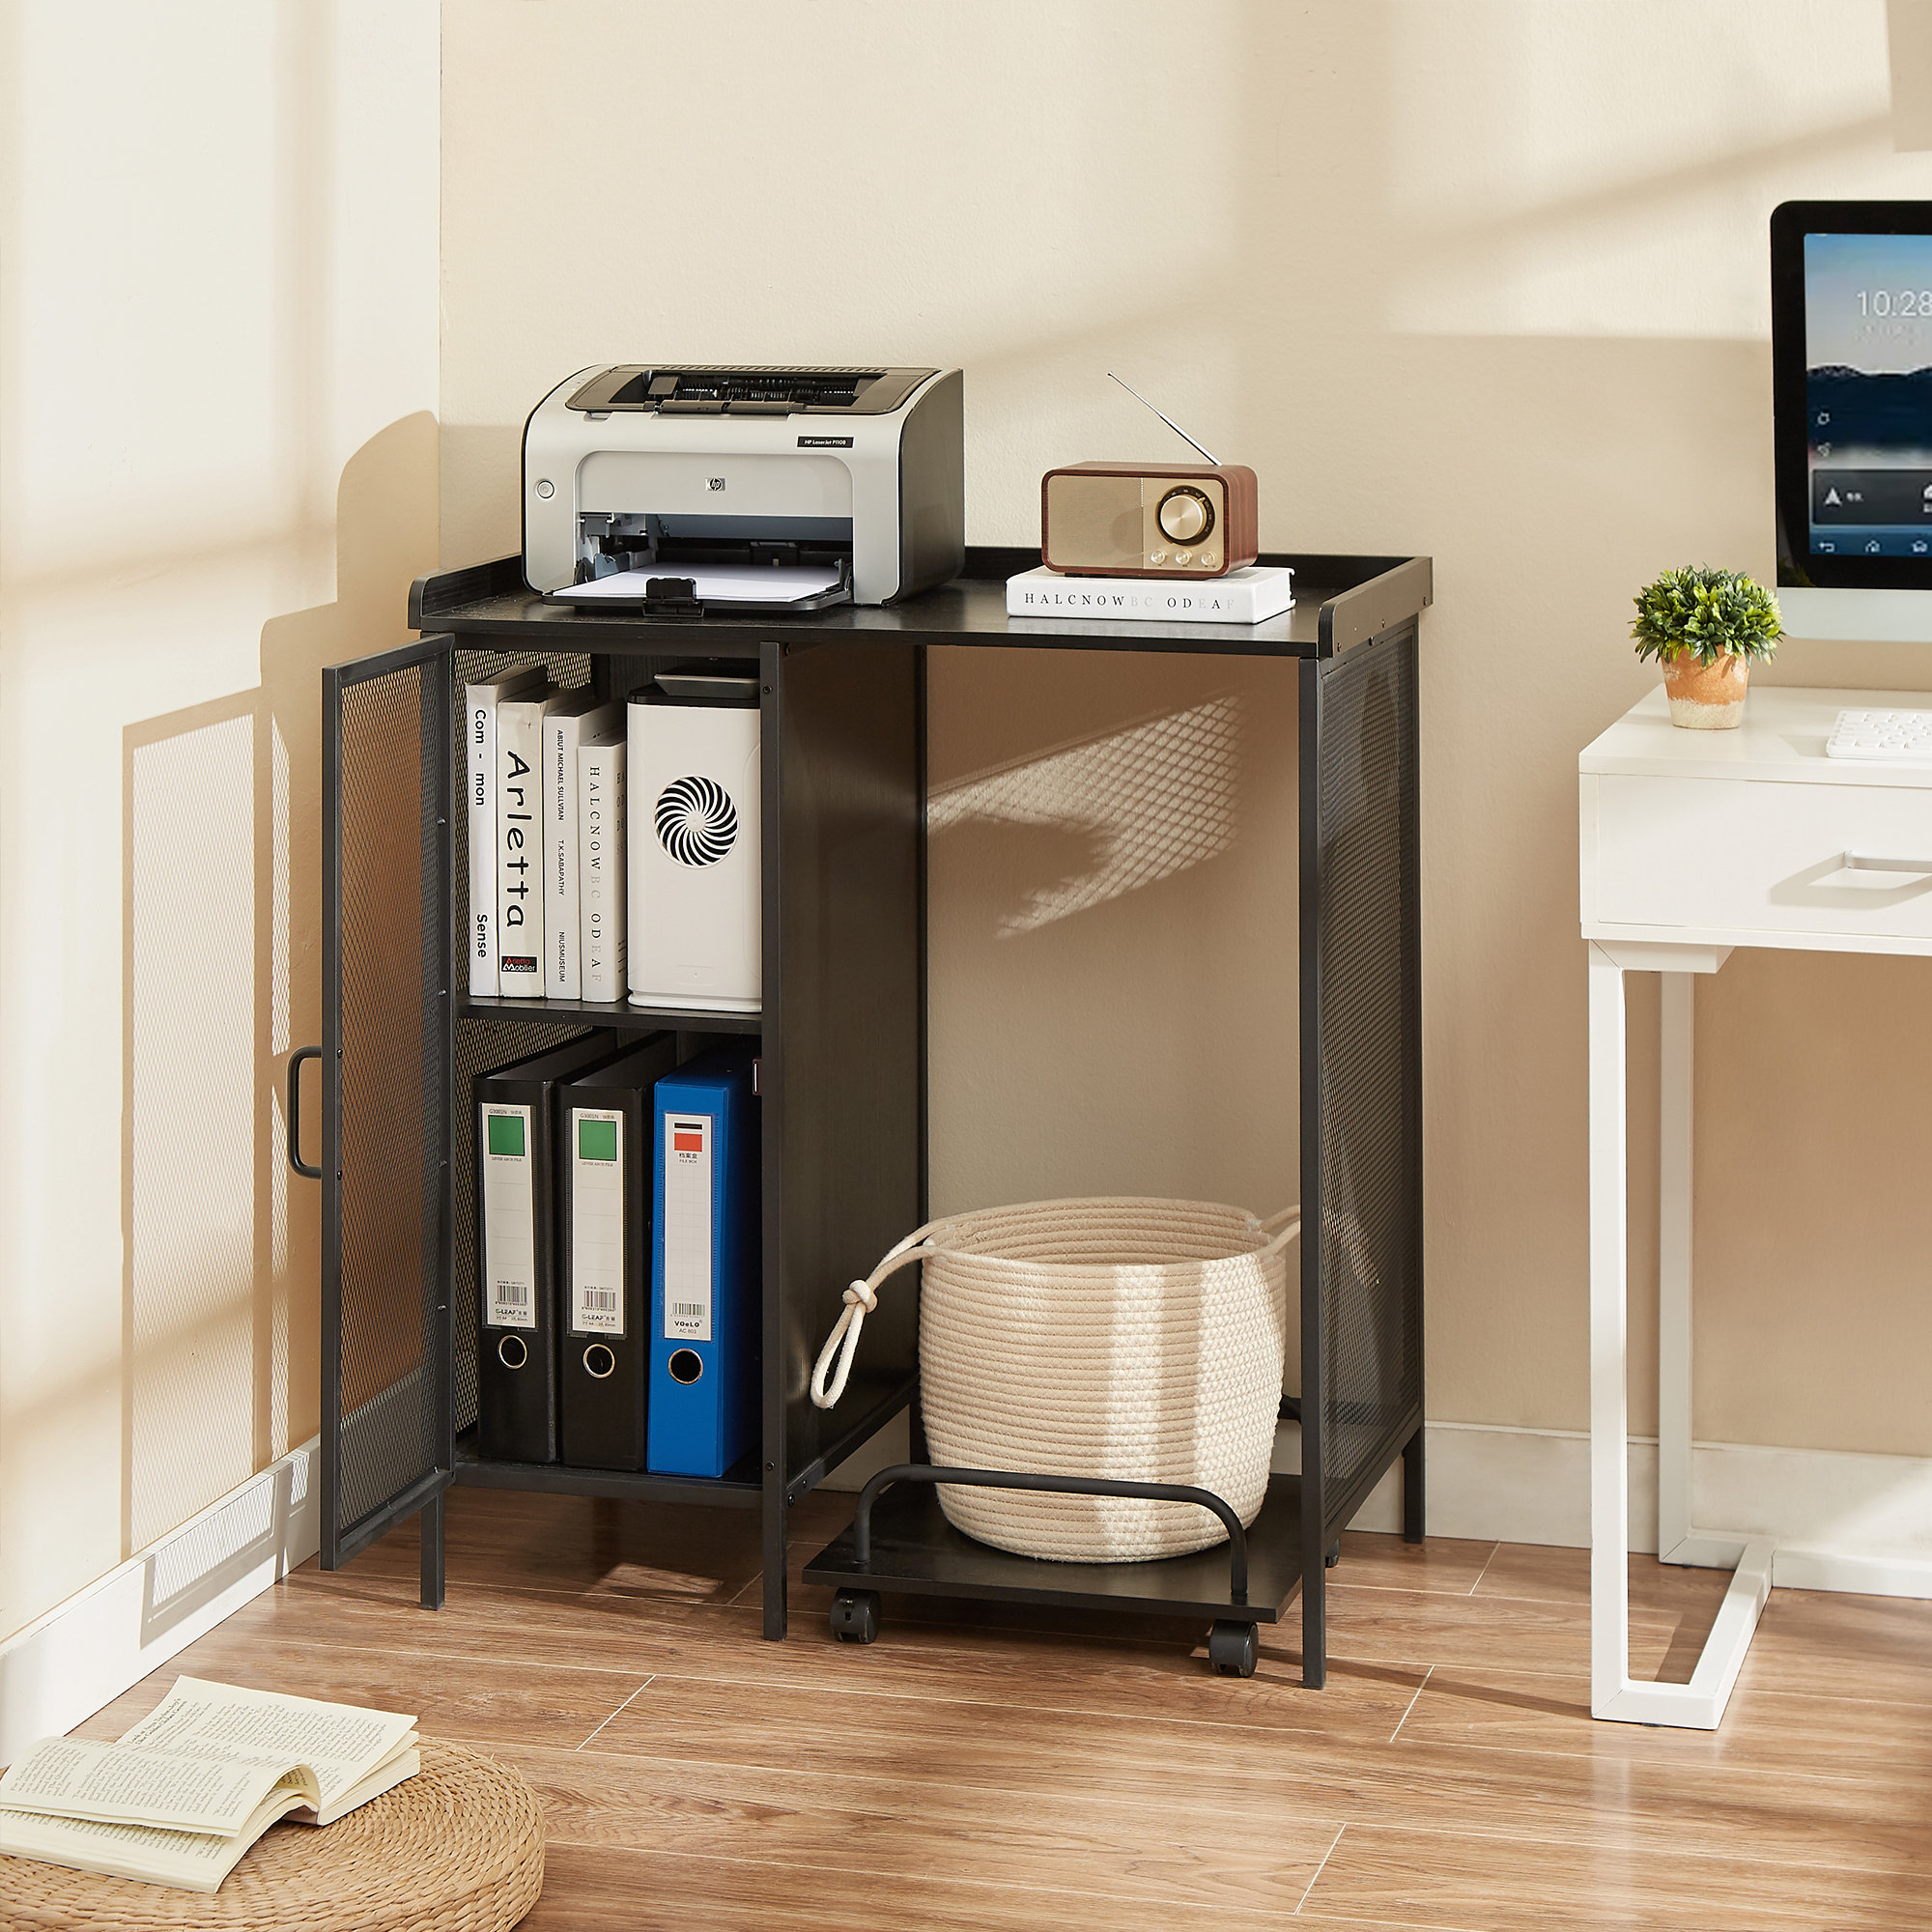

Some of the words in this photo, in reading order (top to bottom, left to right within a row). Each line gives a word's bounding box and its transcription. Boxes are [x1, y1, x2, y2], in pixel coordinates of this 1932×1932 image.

[474, 709, 487, 744] Com
[475, 773, 485, 806] mon
[507, 751, 532, 927] Arletta
[476, 914, 488, 958] Sense
